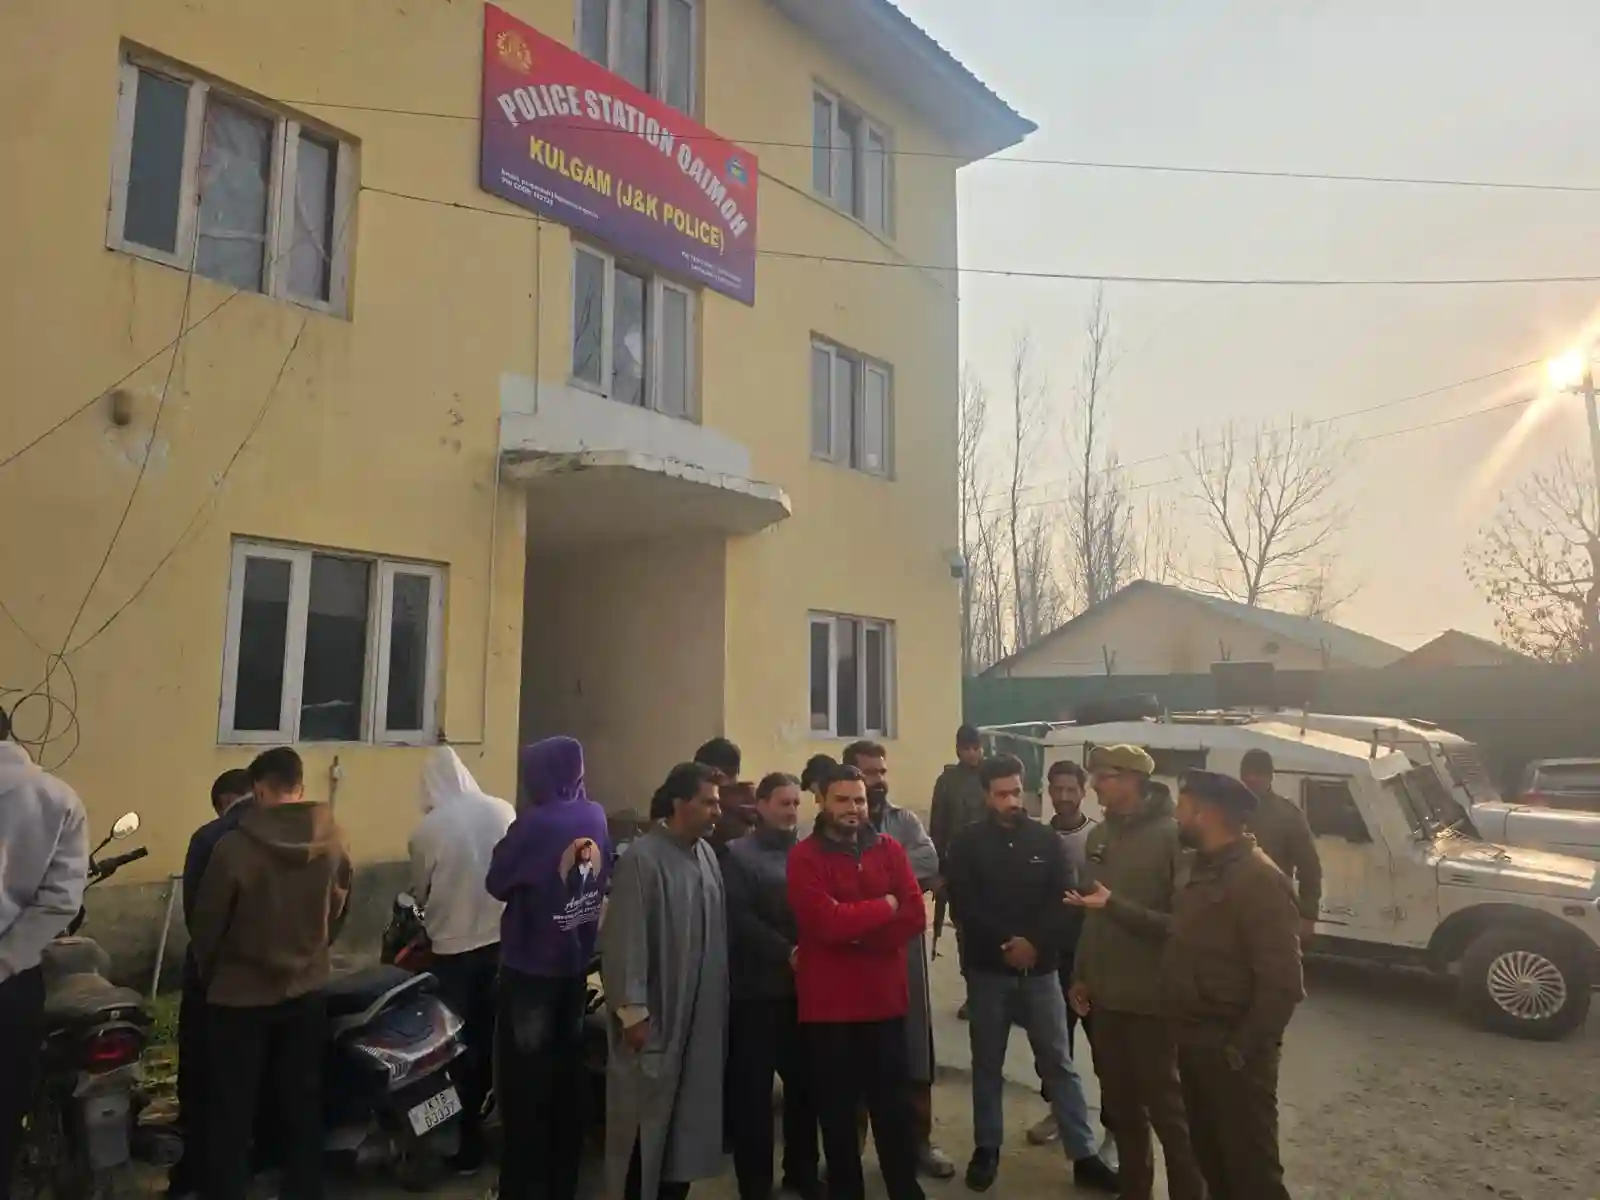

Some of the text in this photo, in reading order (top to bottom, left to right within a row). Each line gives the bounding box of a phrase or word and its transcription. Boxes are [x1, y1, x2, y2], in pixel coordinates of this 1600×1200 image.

[498, 84, 582, 127] POLICE
[584, 89, 674, 157] STATION
[678, 144, 748, 238] QAIMOH
[530, 135, 612, 197] KULGAM
[617, 179, 658, 220] (J&K
[663, 203, 724, 255] POLICE)
